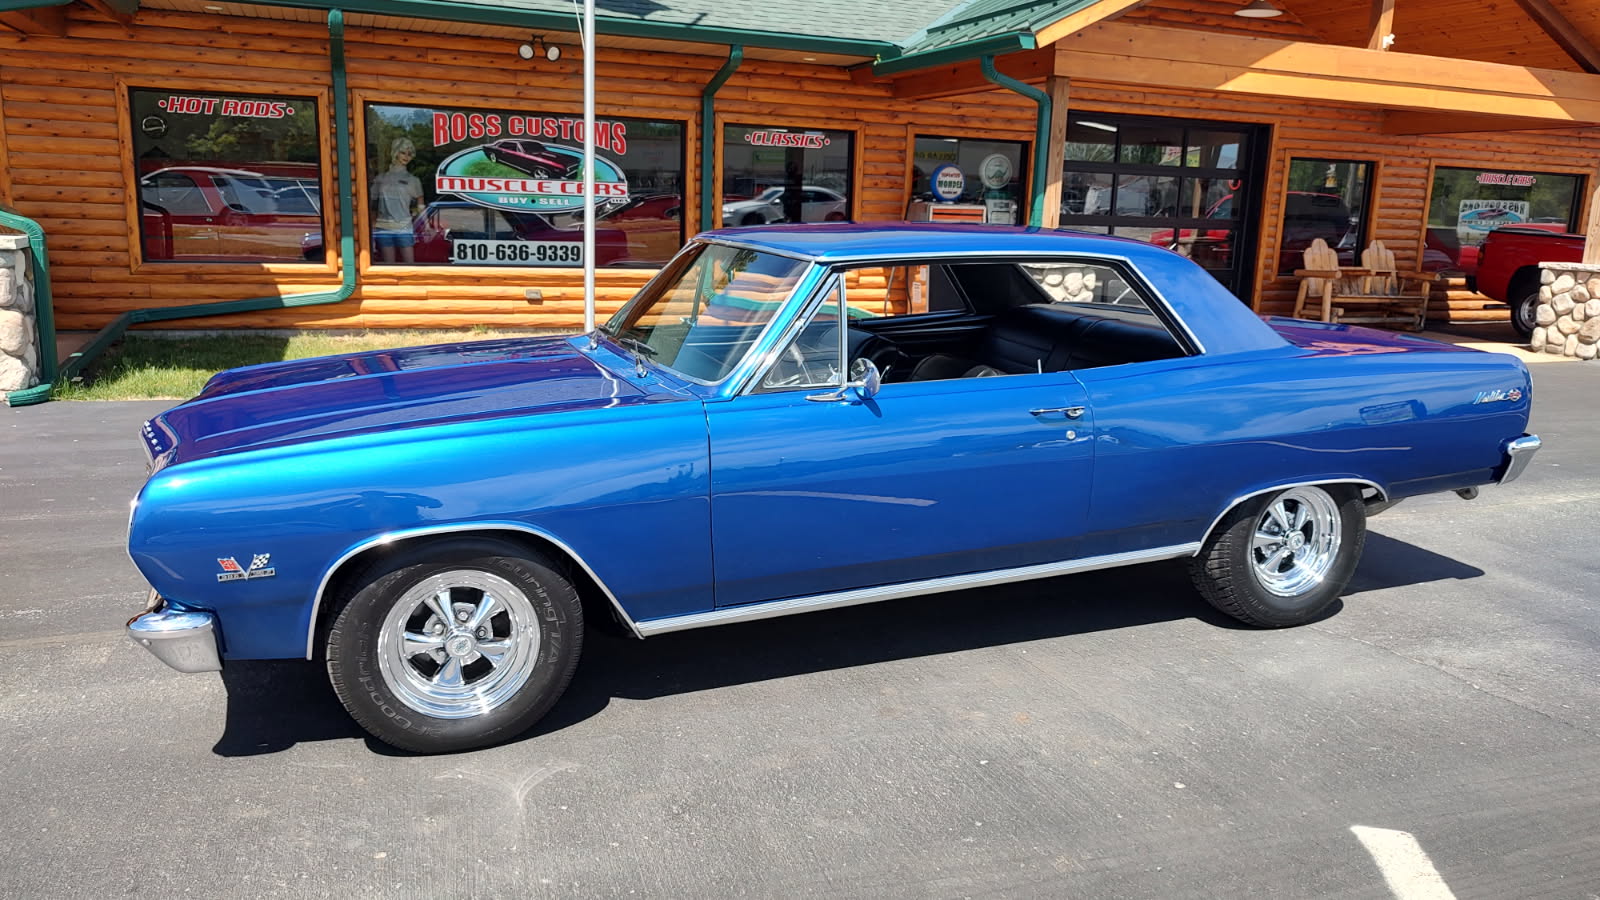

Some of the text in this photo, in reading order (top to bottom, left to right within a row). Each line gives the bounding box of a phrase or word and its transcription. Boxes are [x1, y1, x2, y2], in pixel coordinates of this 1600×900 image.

[167, 96, 287, 118] HOT RODS
[433, 112, 626, 155] ROSS CUSTOMS
[751, 131, 825, 149] CLASSICS
[437, 177, 553, 193] MUSCLE
[1479, 173, 1533, 186] MUSCLE CARS
[498, 196, 571, 206] BUY SELL
[457, 243, 581, 262] 810-636-9339
